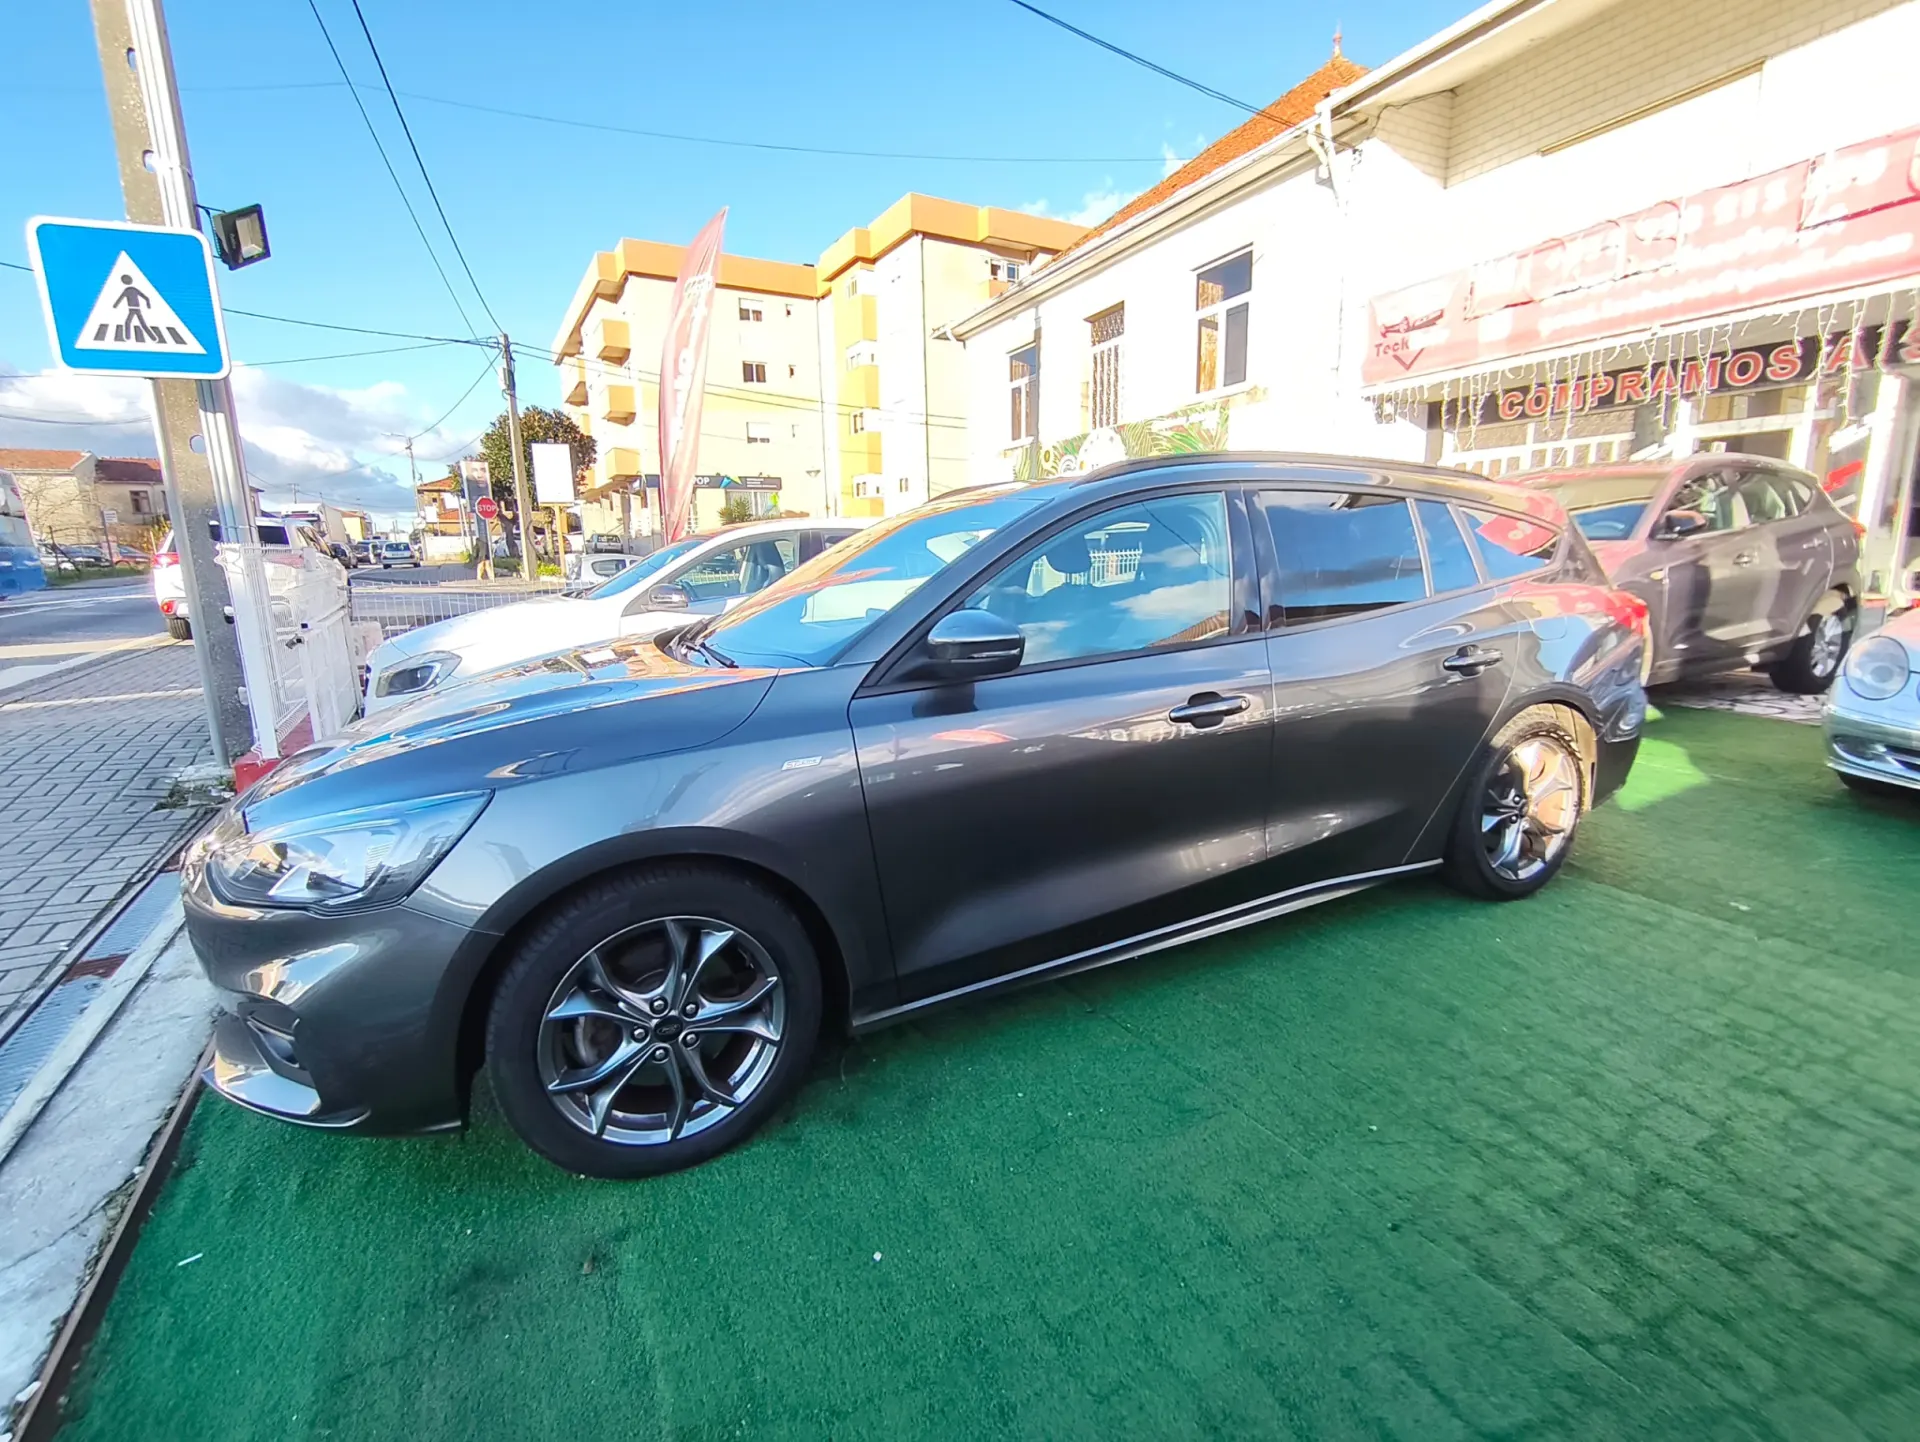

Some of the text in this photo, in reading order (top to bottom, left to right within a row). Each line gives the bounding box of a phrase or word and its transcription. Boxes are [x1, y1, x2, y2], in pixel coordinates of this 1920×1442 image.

[1500, 344, 1801, 420] COMPRAMOS
[1823, 333, 1871, 373] A
[478, 504, 497, 512] STOP
